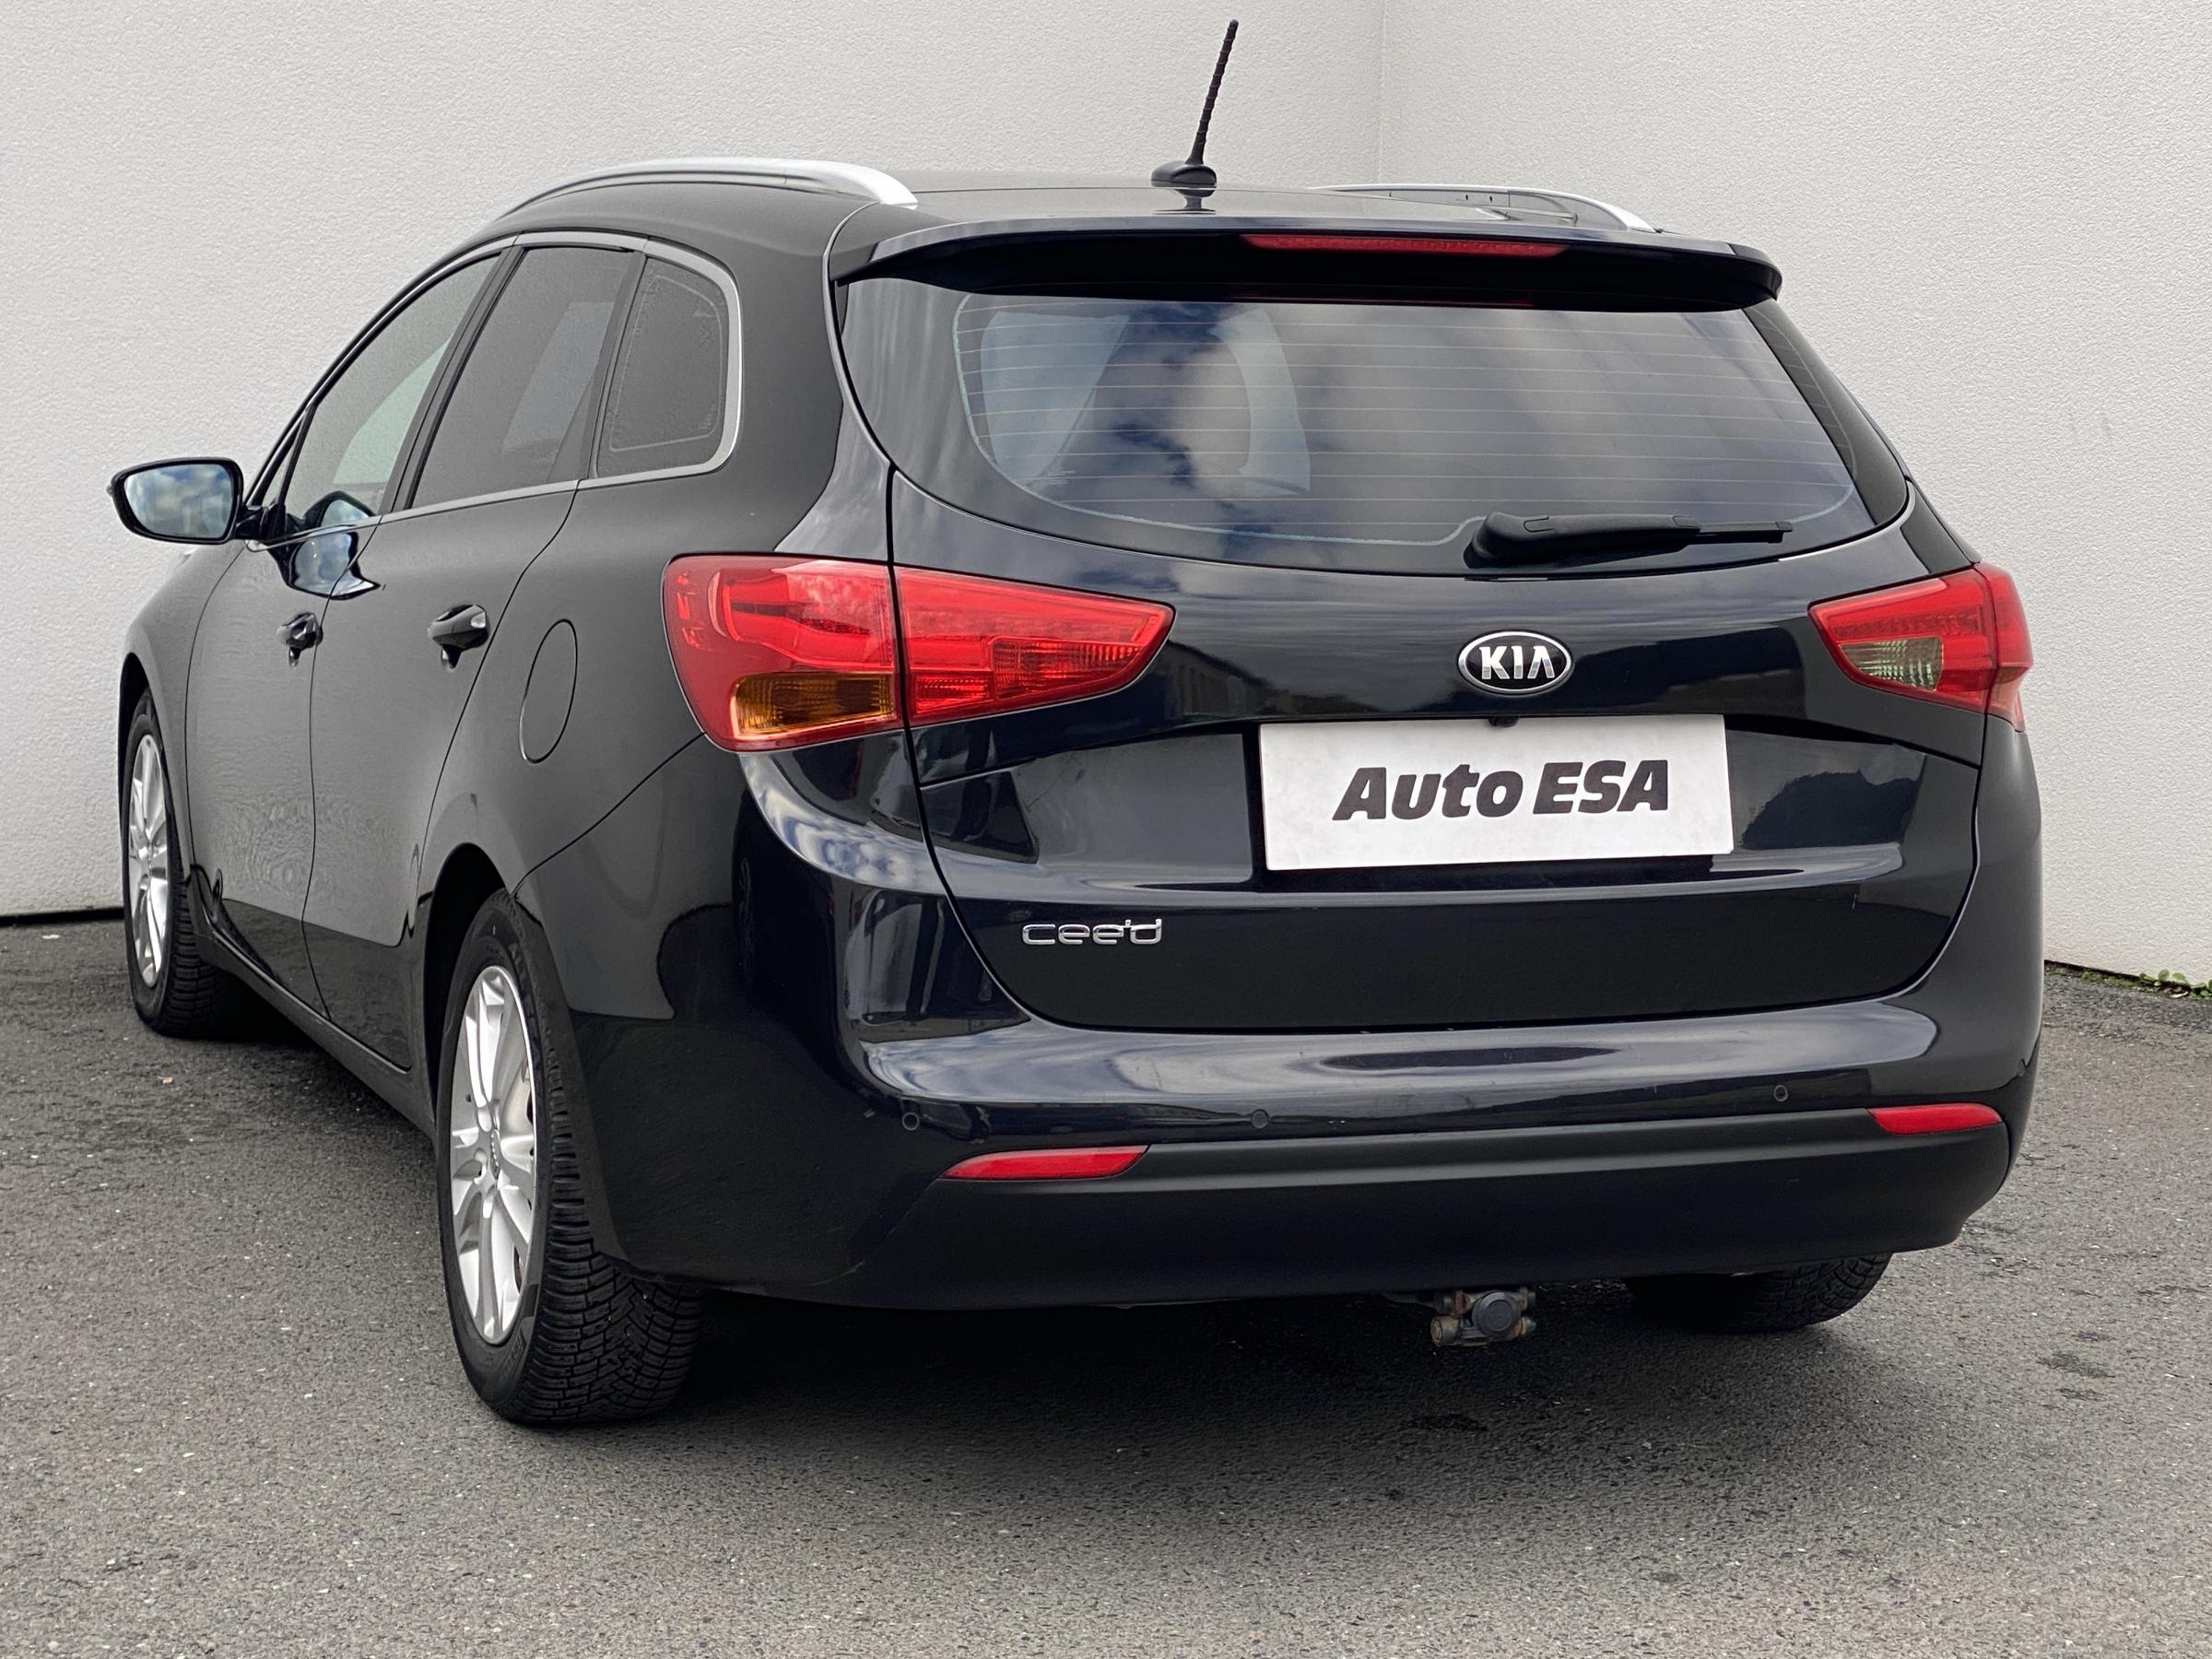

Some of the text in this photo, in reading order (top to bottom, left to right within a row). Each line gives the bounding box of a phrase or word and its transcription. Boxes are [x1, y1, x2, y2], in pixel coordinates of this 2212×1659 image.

[1479, 645, 1556, 679] KIA
[1332, 759, 1668, 820] Auto ESA
